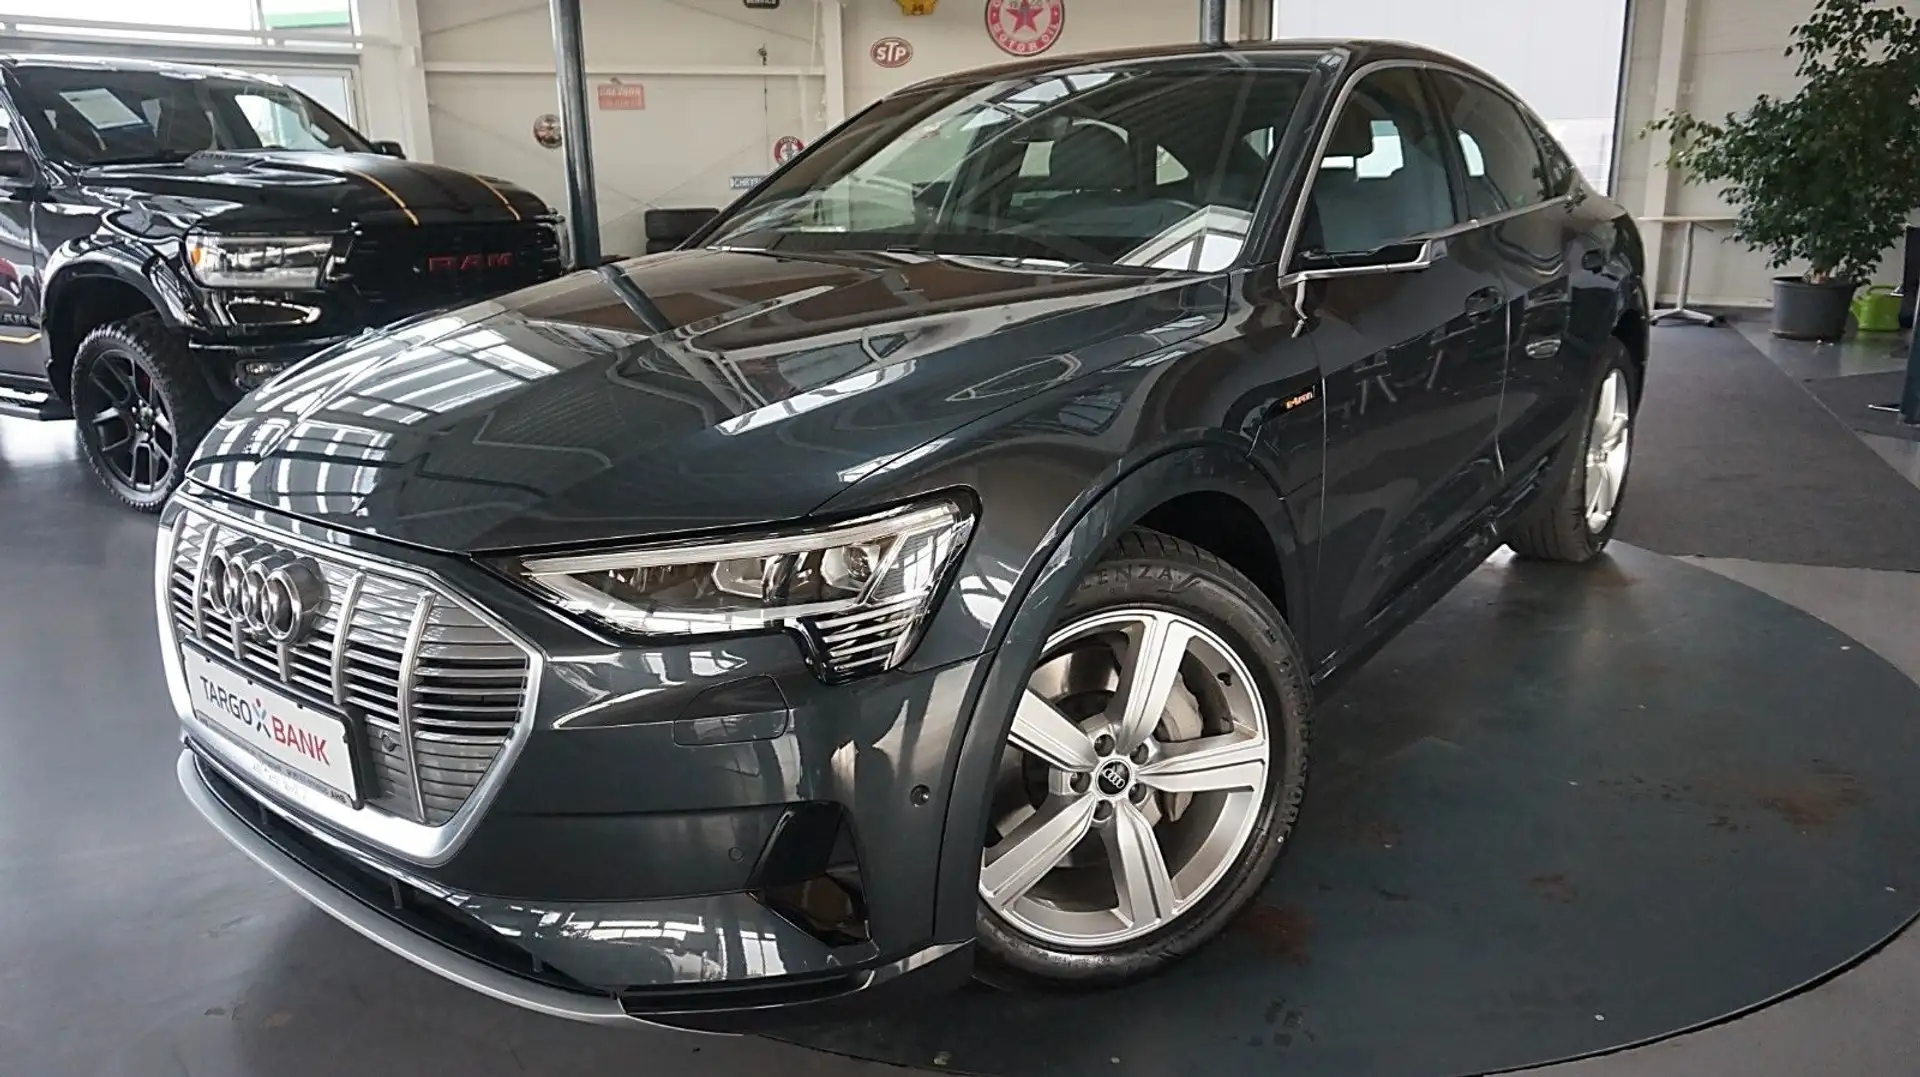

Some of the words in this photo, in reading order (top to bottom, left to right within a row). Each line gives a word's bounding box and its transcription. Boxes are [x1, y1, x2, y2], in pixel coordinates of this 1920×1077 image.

[876, 42, 906, 62] STP
[428, 252, 513, 273] RAM
[200, 676, 252, 726] TARGO
[271, 716, 330, 767] BANK
